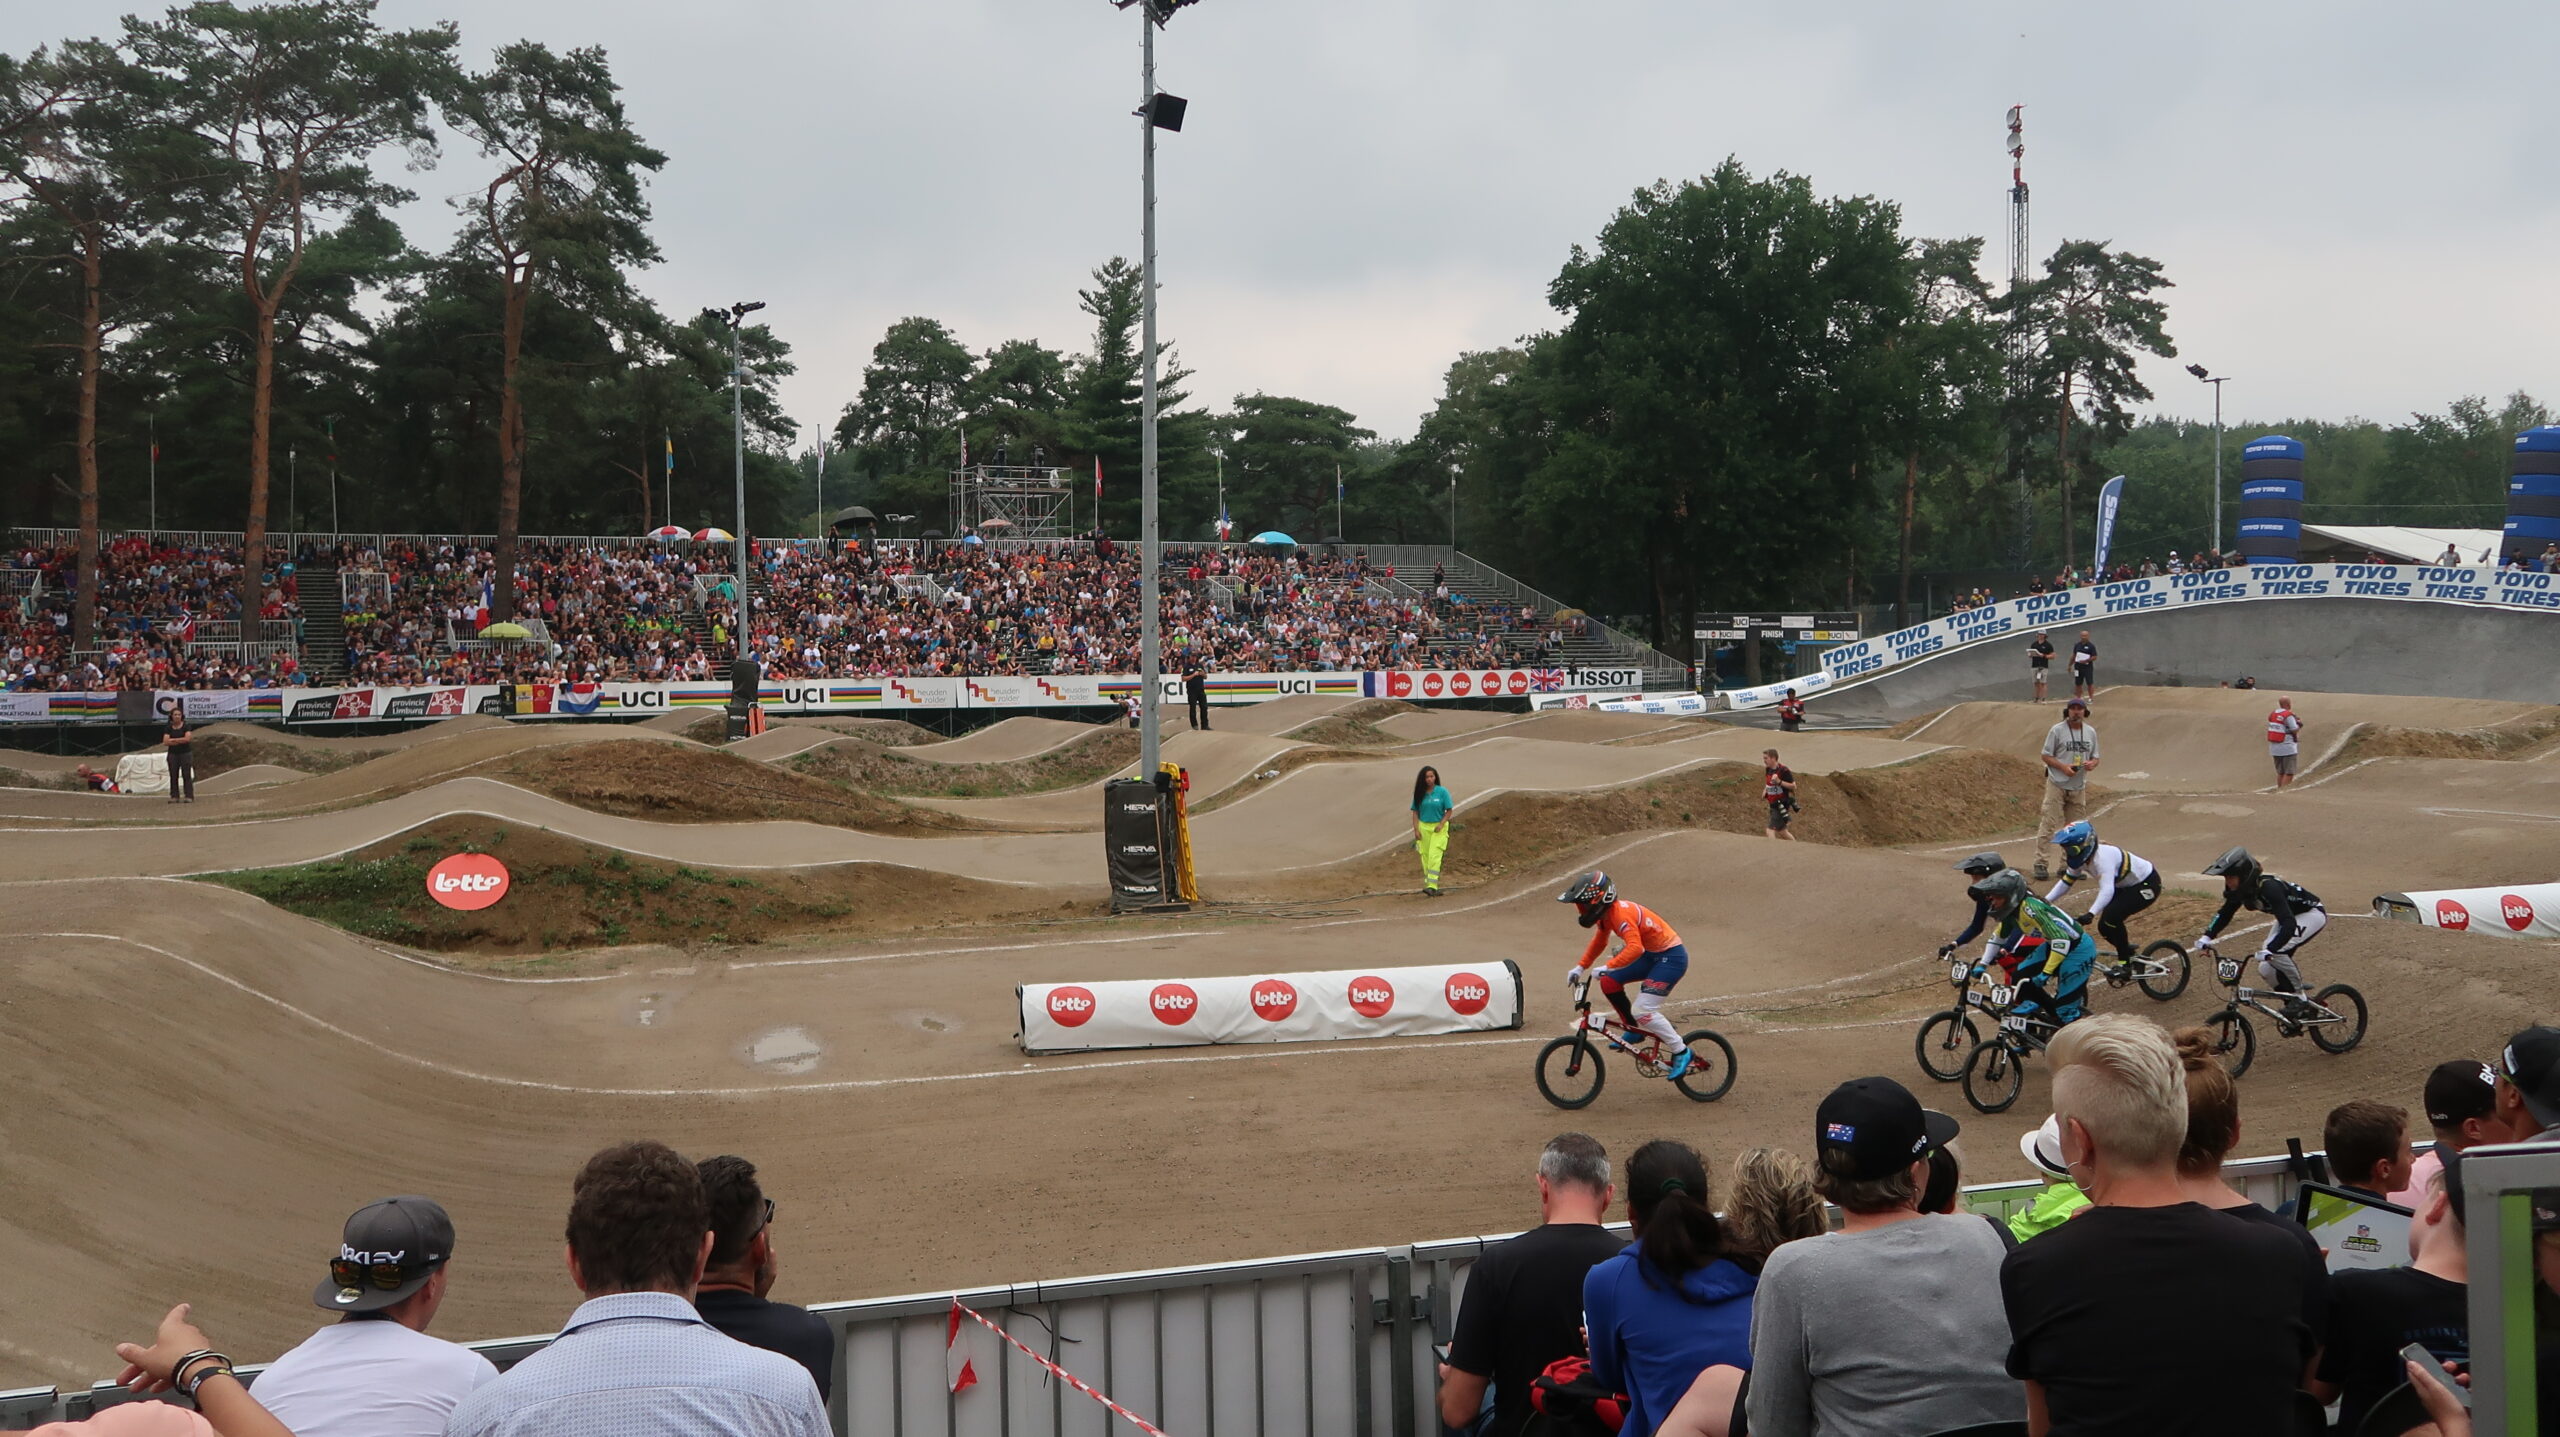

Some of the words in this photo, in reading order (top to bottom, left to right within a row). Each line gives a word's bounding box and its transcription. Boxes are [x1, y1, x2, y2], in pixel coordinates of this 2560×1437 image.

[2170, 570, 2230, 588] TOYO
[2251, 565, 2313, 581] TOYO
[2335, 564, 2398, 580] TOYO
[2417, 567, 2476, 584] TOYO
[2494, 571, 2550, 589] TOYO
[2093, 579, 2151, 600] TOYO
[2181, 583, 2247, 602] TIRES
[2261, 580, 2329, 595] TIRES
[2343, 580, 2412, 596] TIRES
[2425, 583, 2488, 600] TIRES
[2015, 591, 2071, 612] TOYO
[2104, 592, 2168, 613] TIRES
[2501, 588, 2560, 607] TIRES
[1947, 605, 1996, 630] TOYO
[2026, 604, 2087, 626] TIRES
[1761, 630, 1784, 638] FINISH
[1886, 625, 1930, 648] TOYO
[1957, 617, 2012, 643] TIRES
[1824, 643, 1869, 666] TOYO
[1895, 635, 1943, 661] TIRES
[1834, 654, 1883, 680] TIRES
[1566, 670, 1636, 686] TISSOT
[785, 688, 825, 703] UCI
[1280, 680, 1310, 694] UCI
[298, 702, 331, 710] provincie
[392, 699, 425, 709] provincie
[622, 691, 664, 707] UCI
[435, 873, 502, 893] Lotto
[2220, 963, 2237, 977] 308
[1051, 996, 1092, 1012] Lotto
[1154, 993, 1194, 1009] Lotto
[1255, 991, 1293, 1007] Lotto
[1352, 987, 1390, 1003] Lotto
[1449, 984, 1486, 1001] Lotto
[1969, 992, 1980, 1002] 121
[1995, 990, 2007, 1004] 78
